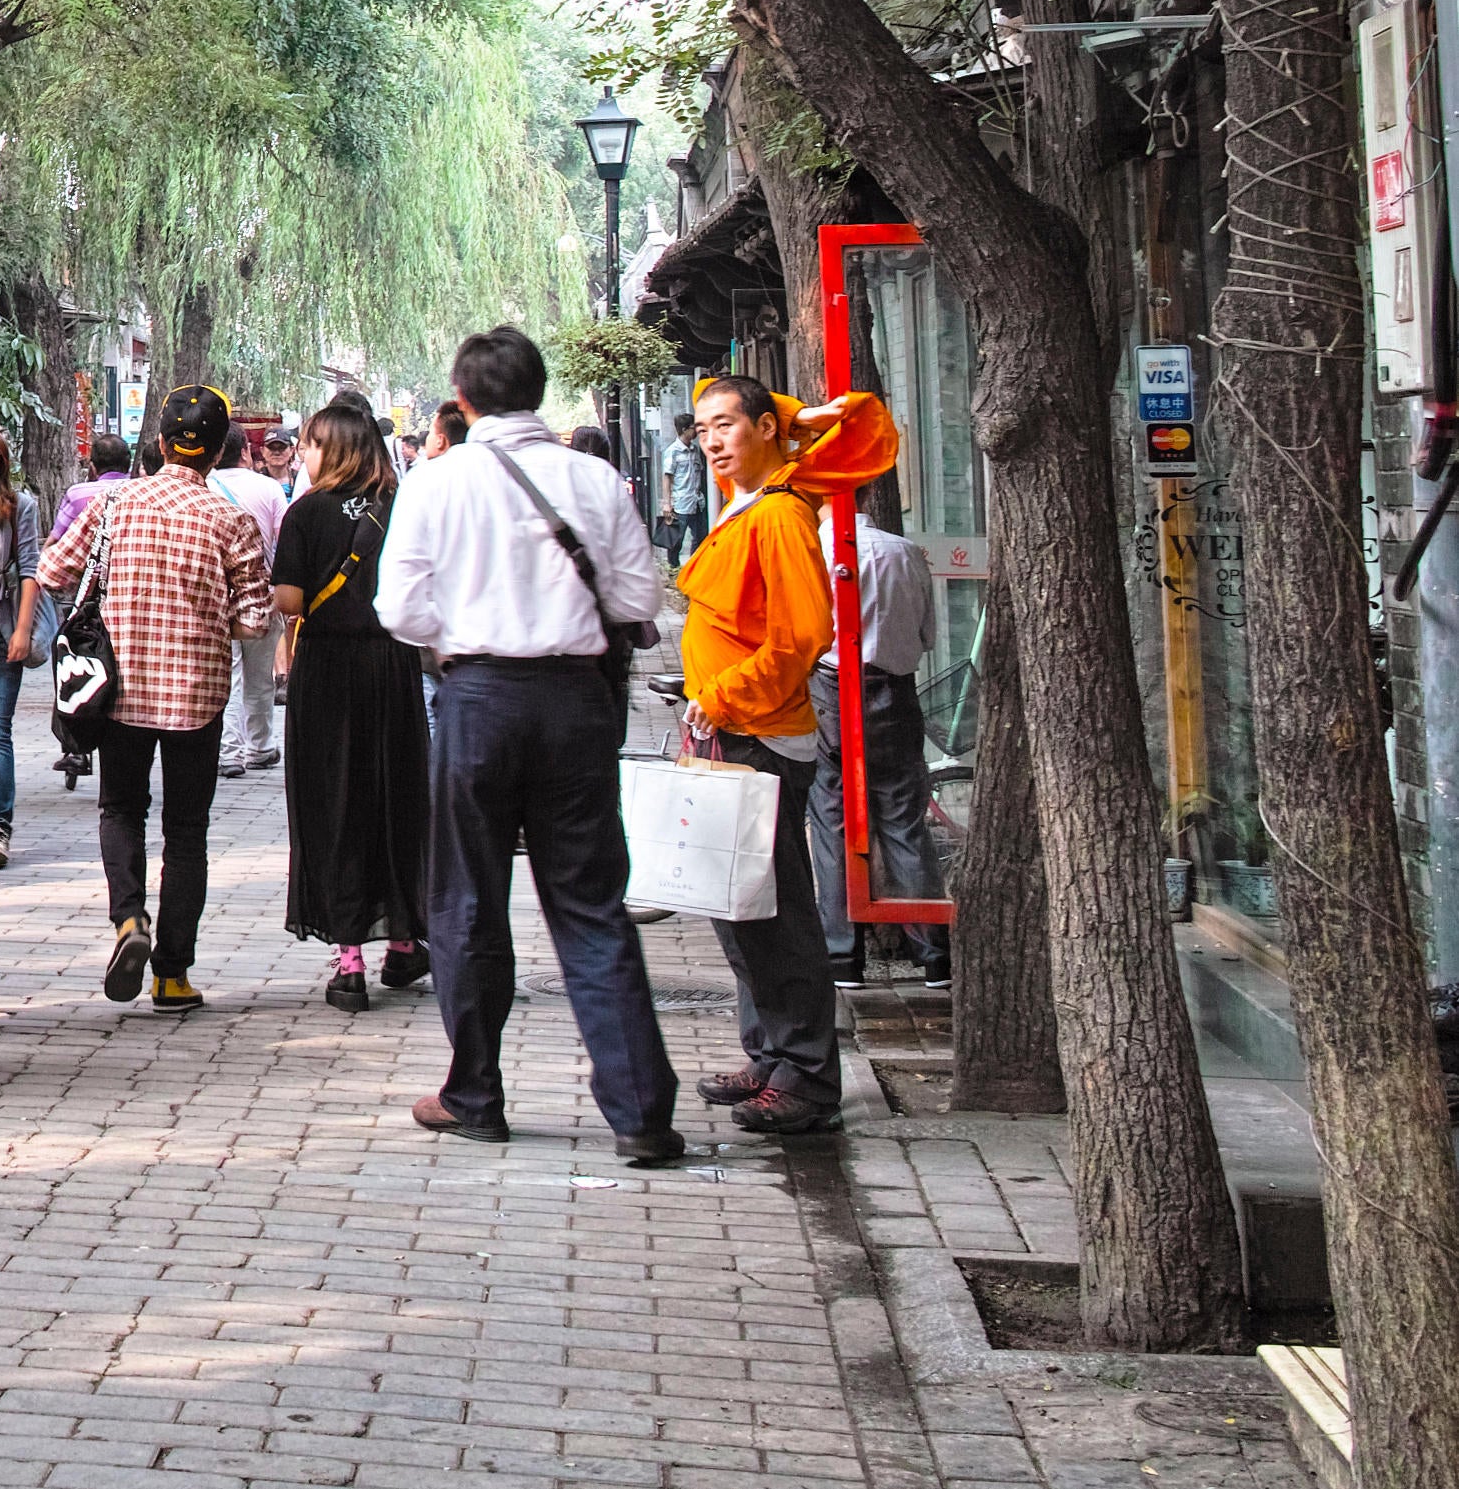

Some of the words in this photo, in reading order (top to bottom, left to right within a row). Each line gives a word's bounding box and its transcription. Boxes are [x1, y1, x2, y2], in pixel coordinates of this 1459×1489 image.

[1160, 358, 1180, 368] with
[1145, 370, 1185, 384] VISA
[1146, 397, 1184, 409] 休息中
[1149, 410, 1183, 418] CLOSED
